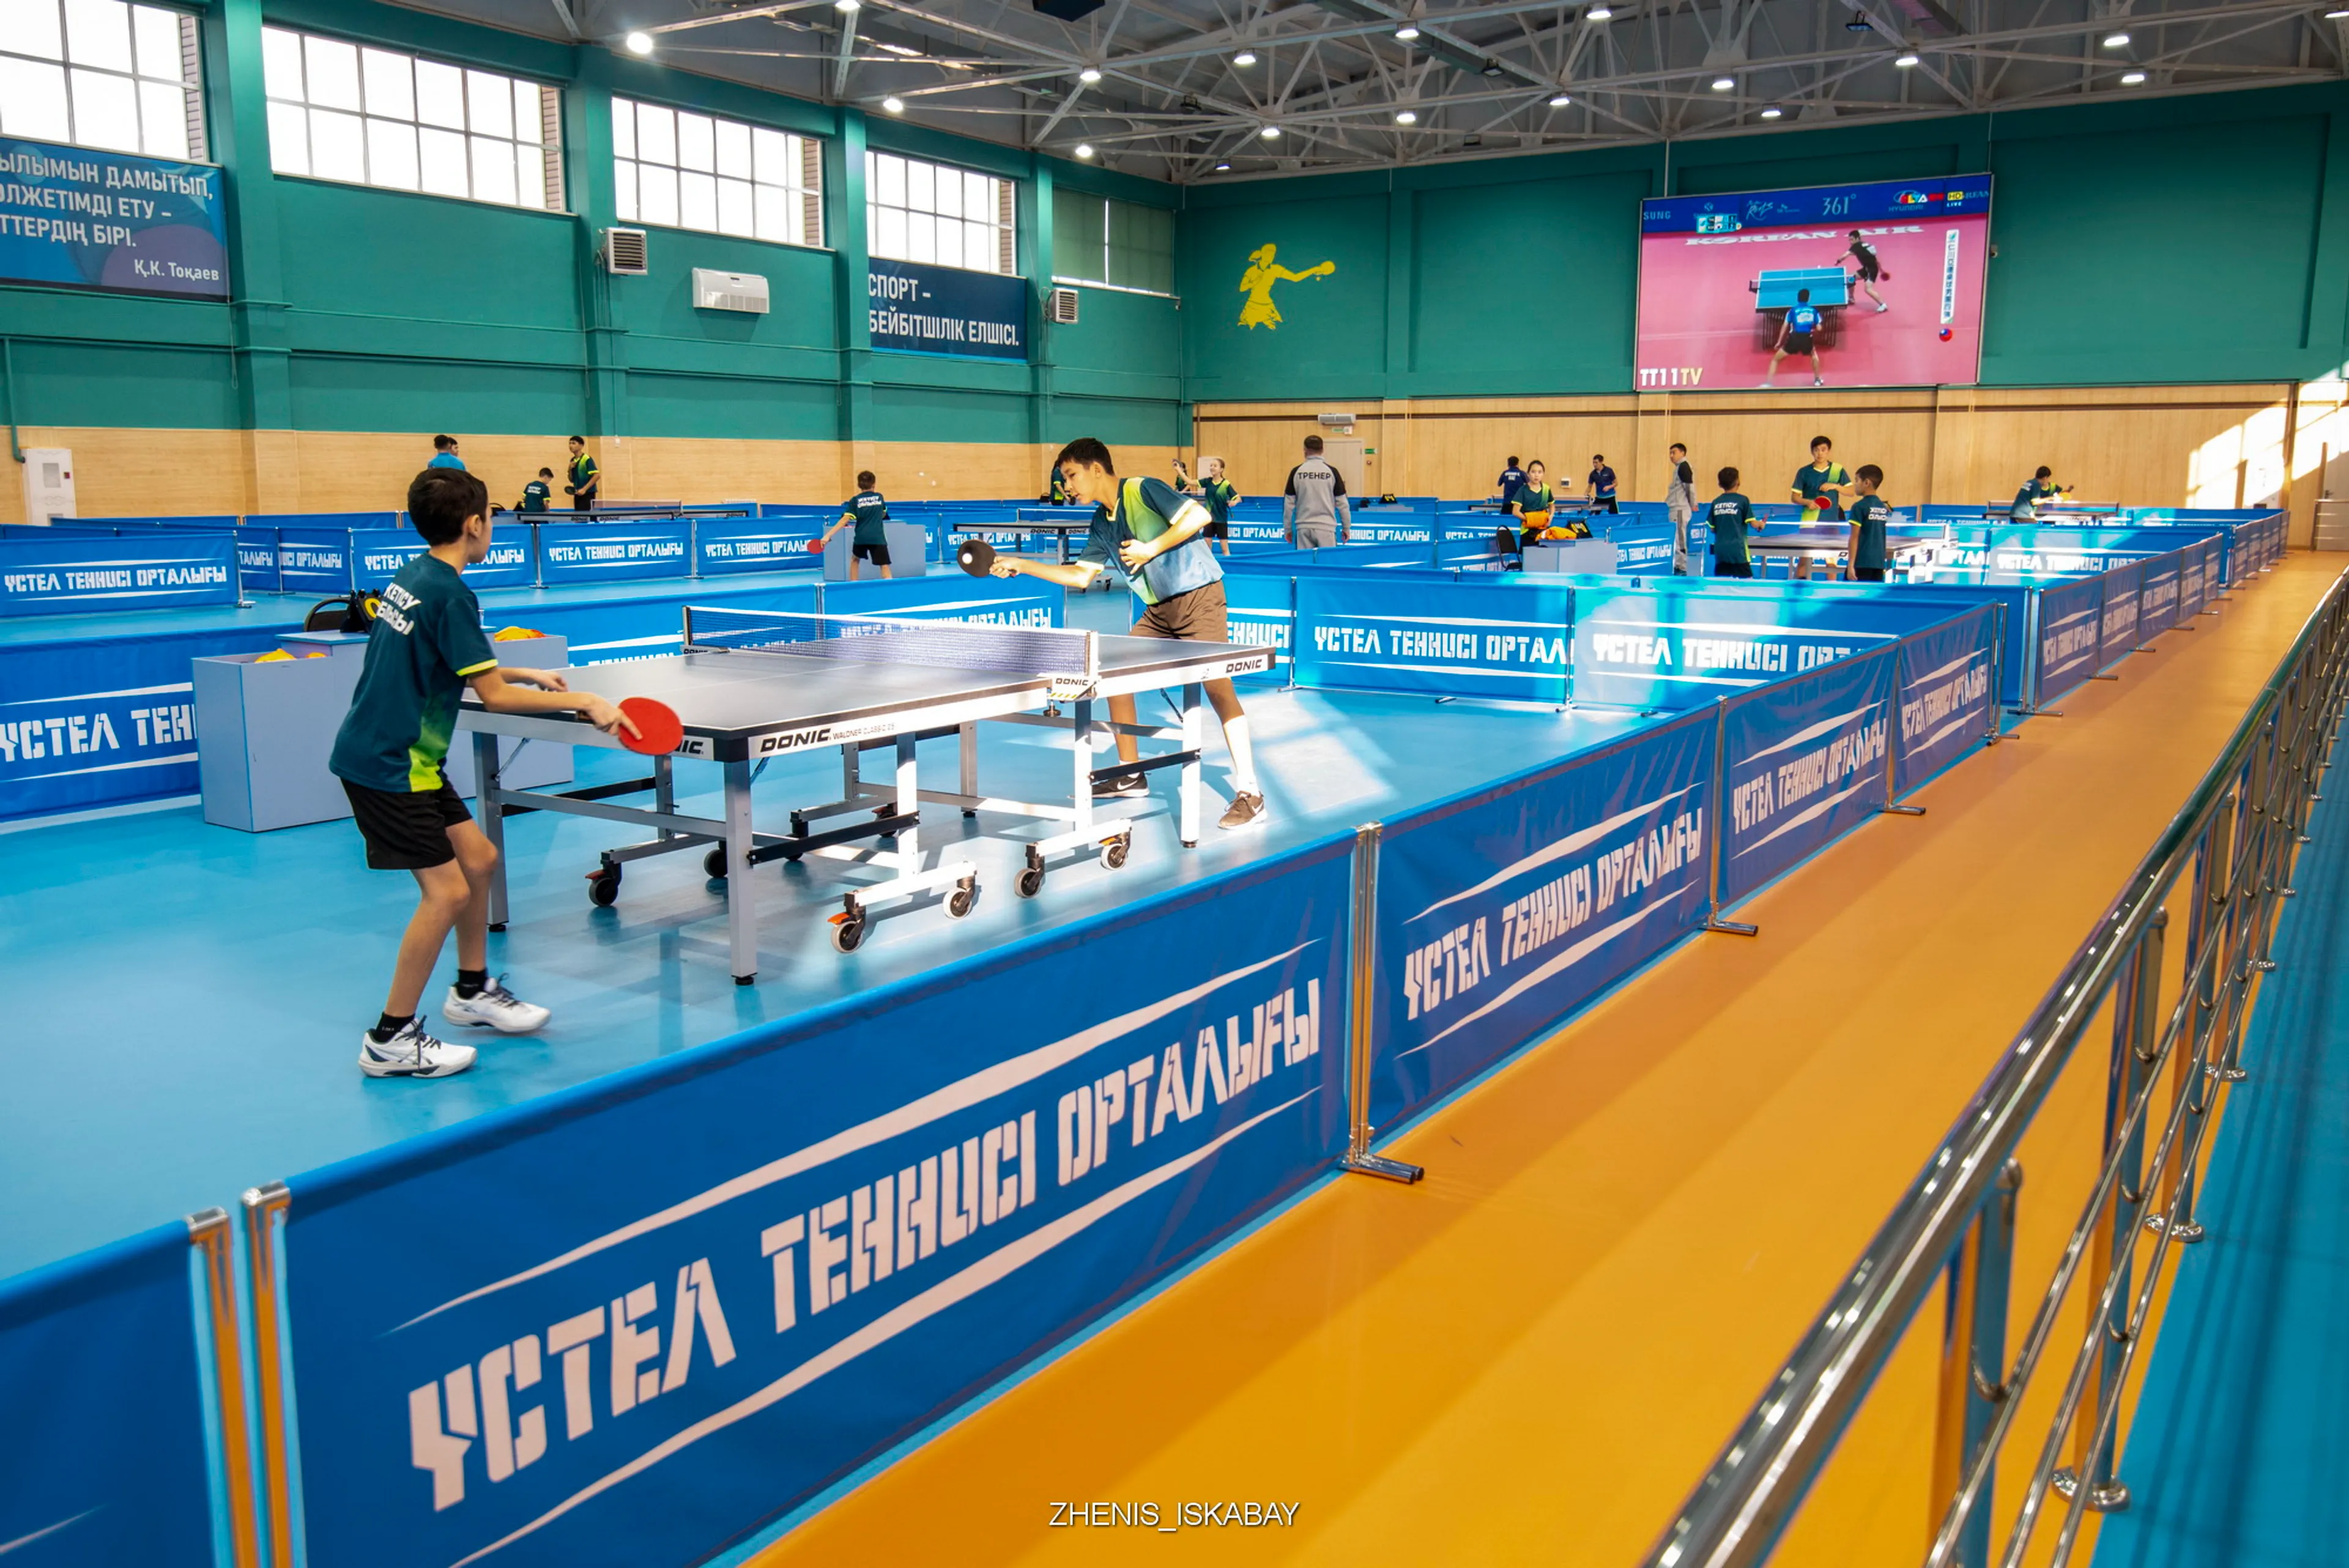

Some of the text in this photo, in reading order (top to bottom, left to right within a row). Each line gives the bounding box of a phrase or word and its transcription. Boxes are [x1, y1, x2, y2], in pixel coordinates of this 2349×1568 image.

[105, 166, 213, 200] ДАМЫТЫП,
[1822, 194, 1857, 215] 361°
[1947, 191, 1963, 201] HD
[119, 197, 155, 219] ЕТУ
[1888, 204, 1924, 212] HYUNDAI
[94, 225, 136, 247] БІРІ.
[1685, 230, 1838, 245] KOREAN
[134, 259, 220, 281] Қ.К. Тоқаев
[868, 273, 918, 302] СПОРТ
[869, 306, 1019, 346] БЕЙБІТШІЛІК ЕЛШІСІ.
[1297, 472, 1332, 481] ТРЕНЕР
[1243, 527, 1285, 538] ОРТАЛЫҒ
[773, 539, 811, 553] ОРТАЛЫ
[238, 551, 273, 567] ТАЛЫҒЫ
[5, 565, 227, 593] ҮСТЕЛ ТЕННИСІ ОРТАЛЫҒЫ
[1226, 621, 1290, 648] ЕННИСІ
[1315, 626, 1381, 655] ҮСТЕЛ
[1390, 630, 1477, 660] ТЕННИСІ
[1592, 633, 1673, 665] ҮСТЕЛ
[1682, 638, 1788, 672] ТЕННИСІ
[1226, 658, 1263, 673] DONIC
[1055, 677, 1089, 686] DONIC
[0, 713, 121, 762] ҮСТЕЛ
[760, 728, 831, 752] DONIC
[1733, 772, 1774, 835] ҮСТЕЛ
[1778, 746, 1827, 810] ТЕННИСІ
[1403, 807, 1702, 1022] ҮСТЕЛ ТЕННИСІ ОРТАЛЫҒЫ
[407, 976, 1321, 1514] ҮСТЕЛ ТЕННИСІ ОРТАЛЫҒЫ
